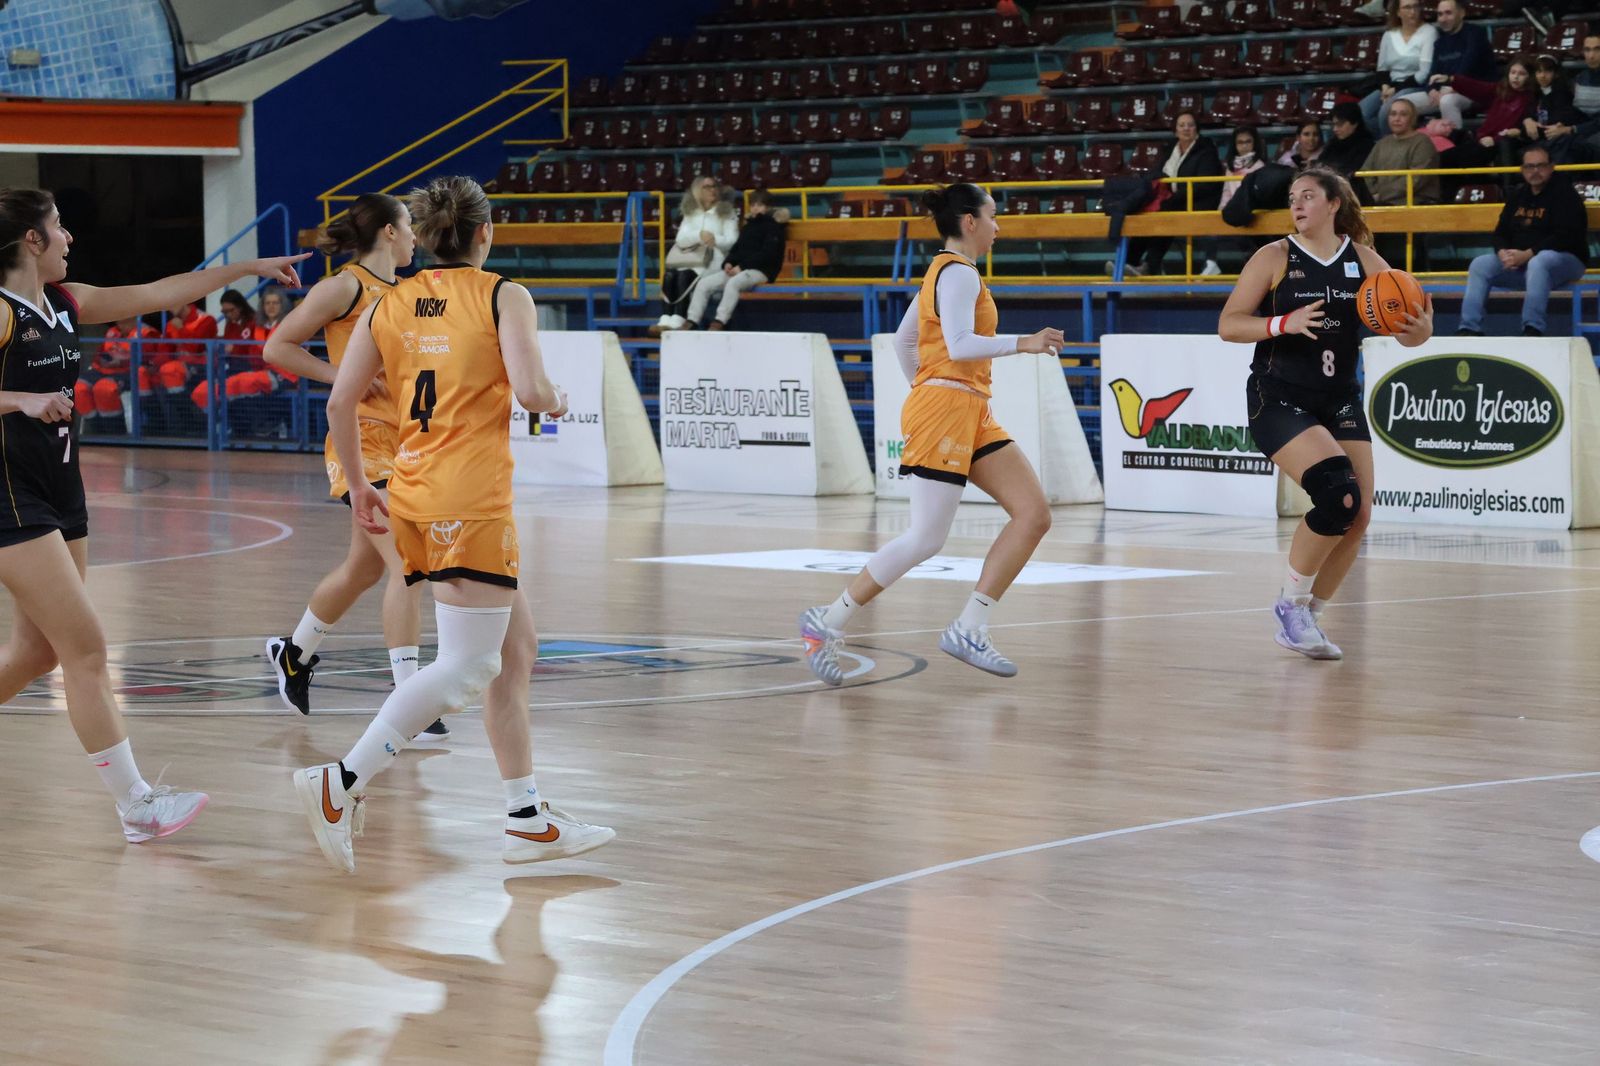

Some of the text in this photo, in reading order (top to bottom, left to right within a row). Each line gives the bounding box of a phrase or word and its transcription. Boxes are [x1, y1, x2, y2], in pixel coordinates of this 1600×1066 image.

[415, 298, 447, 318] NISKI
[1365, 289, 1381, 331] Wilson
[1322, 349, 1335, 377] 8
[410, 370, 437, 433] 4
[665, 378, 810, 417] RESTAURANTE
[1387, 382, 1552, 435] Paulino Iglesias
[579, 414, 599, 424] LUZ
[58, 427, 71, 463] 7
[665, 421, 742, 449] MARTA
[1415, 438, 1514, 452] Embutidos y Jamones
[1123, 454, 1273, 473] EL CENTRO COMERCIAL DE ZAMORA
